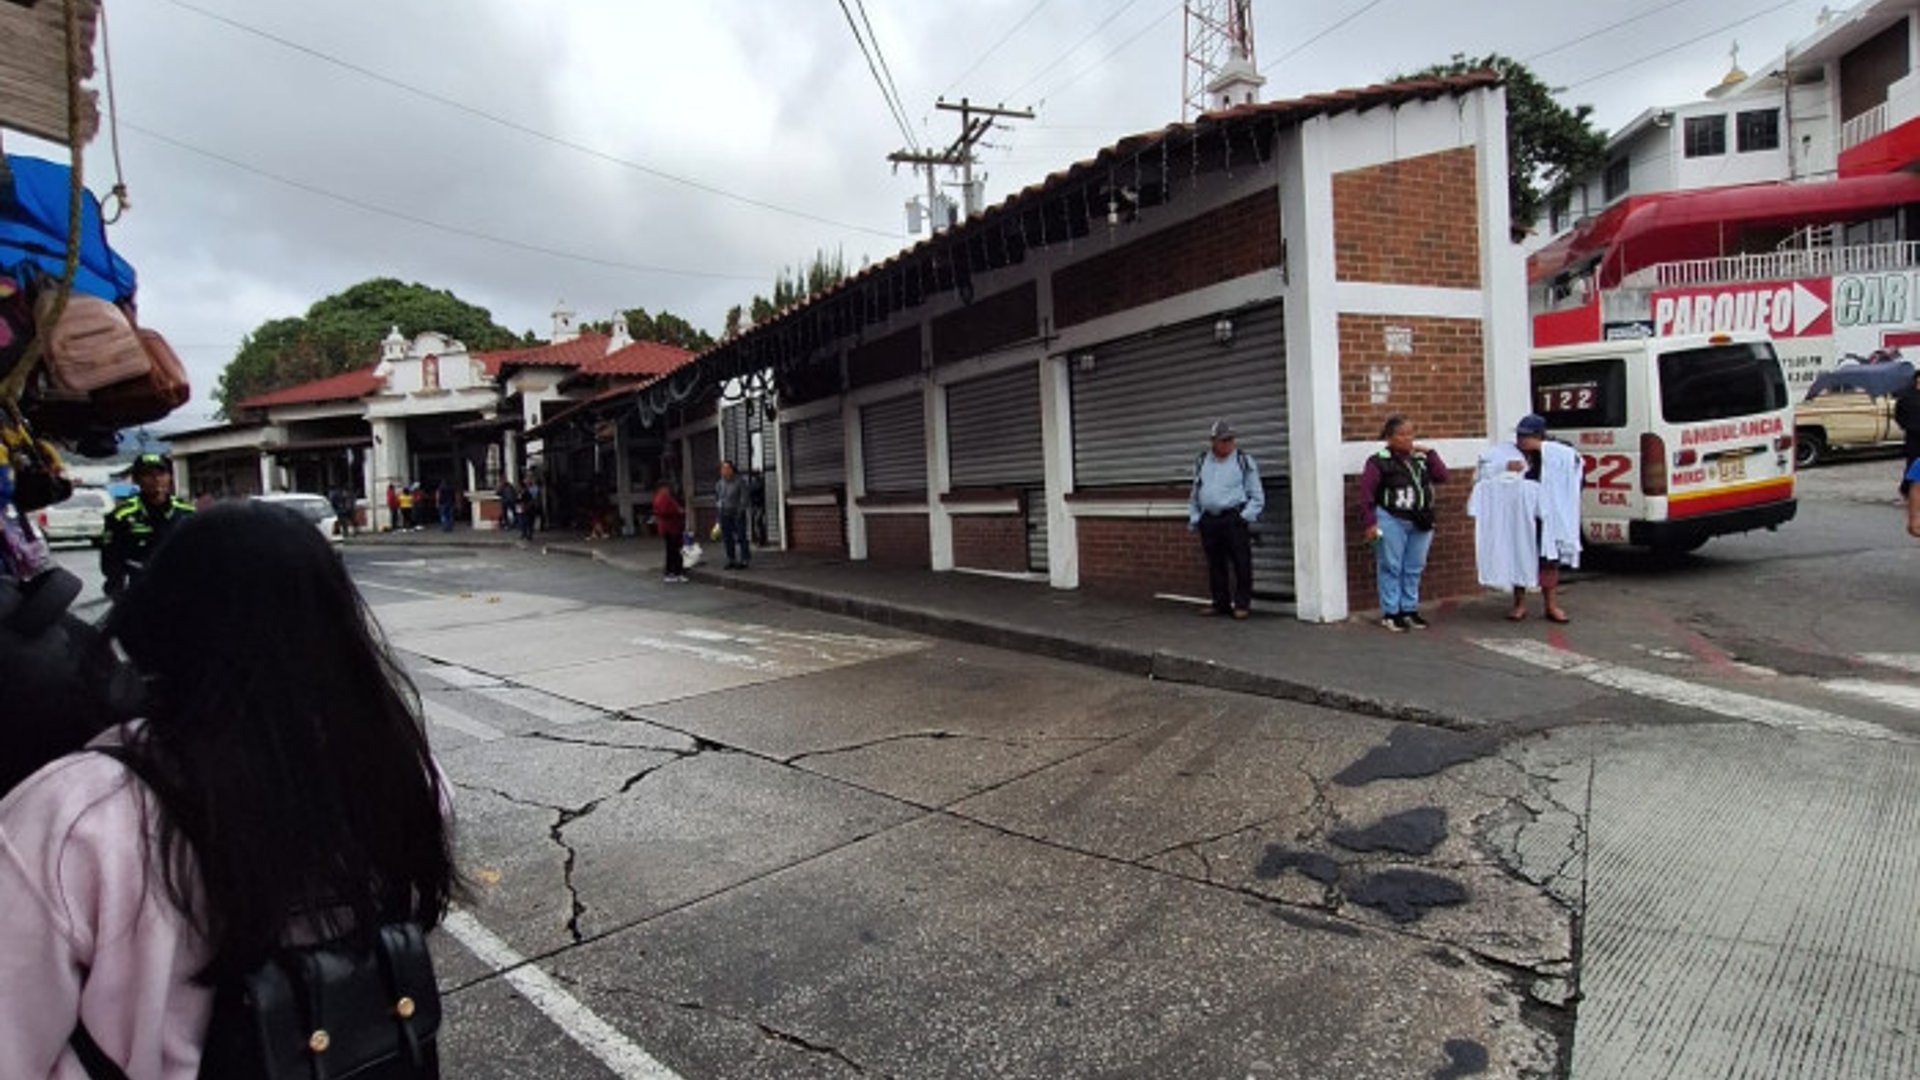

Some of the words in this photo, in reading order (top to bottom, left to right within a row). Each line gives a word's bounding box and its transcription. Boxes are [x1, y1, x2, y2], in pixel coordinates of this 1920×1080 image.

[1656, 287, 1793, 337] PARQUEO
[1836, 273, 1907, 327] CAR
[1544, 389, 1592, 412] 122
[1681, 417, 1784, 445] AMBULANCIA
[1581, 454, 1632, 492] 22
